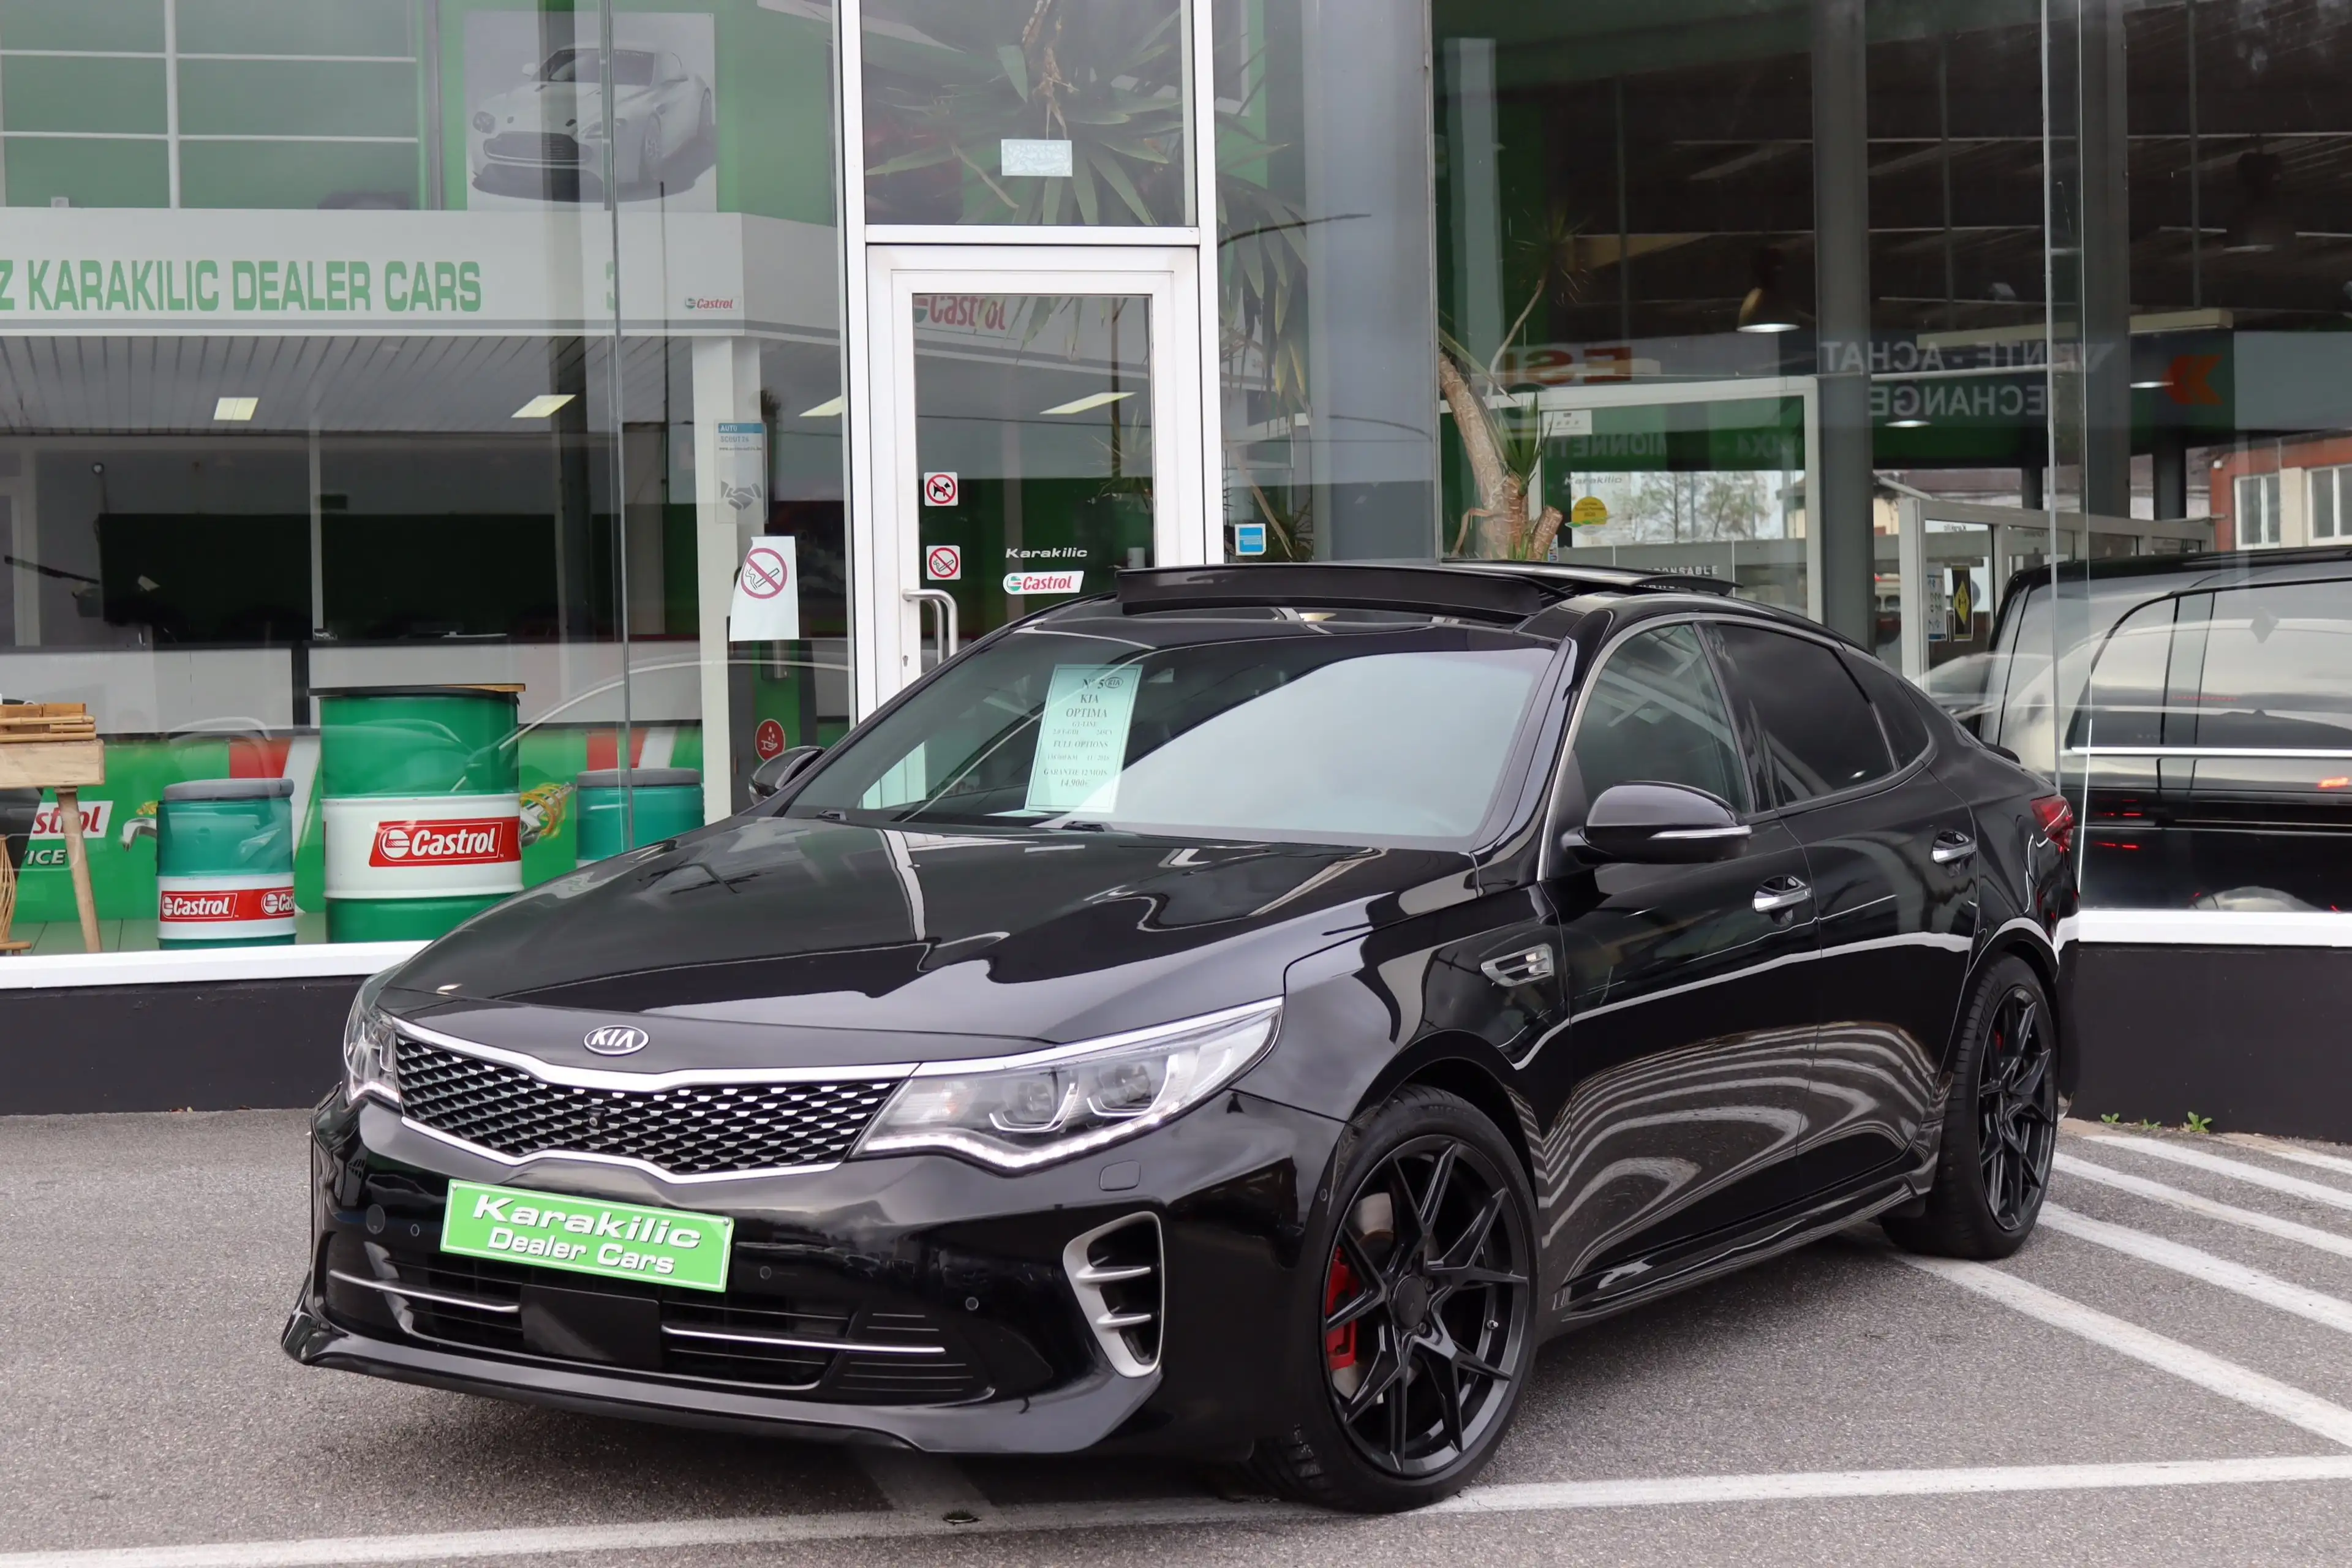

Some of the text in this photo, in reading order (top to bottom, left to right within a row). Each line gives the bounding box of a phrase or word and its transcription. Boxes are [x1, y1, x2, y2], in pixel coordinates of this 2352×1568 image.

[28, 260, 219, 311] KARAKILIC
[232, 261, 371, 311] DEALER
[385, 261, 481, 312] CARS
[696, 298, 733, 309] Castrol
[1005, 547, 1088, 559] Karakilic
[1023, 575, 1072, 591] Castrol
[1080, 694, 1099, 704] KIA
[1066, 708, 1107, 718] OPTIMA
[1074, 740, 1109, 748] OPTIONS
[412, 827, 496, 856] Castrol
[173, 896, 230, 915] Castrol
[590, 1028, 635, 1048] KIA
[472, 1194, 701, 1249] Karakilic
[487, 1227, 675, 1275] Dealer Cars
